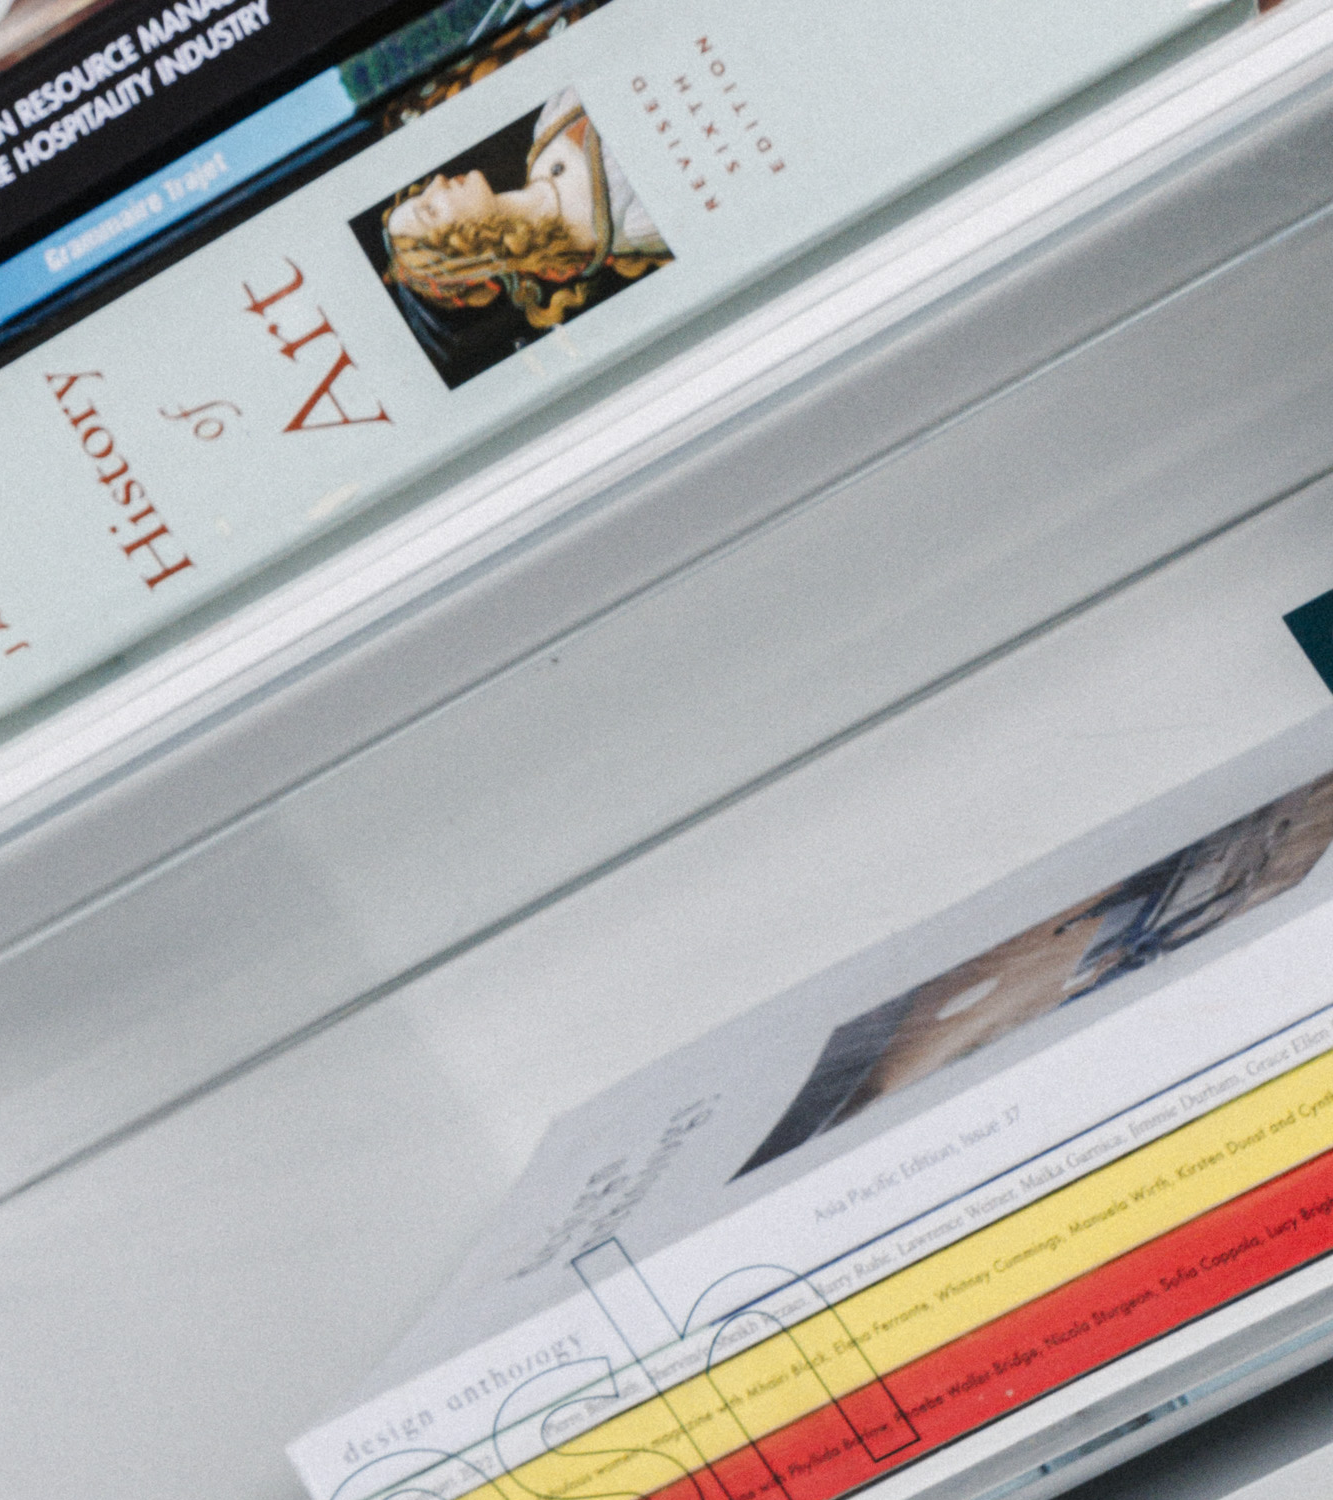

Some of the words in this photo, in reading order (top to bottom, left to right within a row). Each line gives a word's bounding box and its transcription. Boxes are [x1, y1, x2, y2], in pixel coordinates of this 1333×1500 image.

[13, 32, 141, 130] RESOURCE
[14, 66, 156, 175] HOSPITALITY
[632, 75, 720, 212] REVISED
[674, 74, 740, 174] SIXTH
[695, 34, 786, 175] EDITION
[43, 191, 164, 274] Grammaire
[161, 151, 229, 202] Trajet
[242, 256, 395, 435] Art
[45, 369, 196, 590] History
[158, 398, 244, 441] of
[814, 1201, 849, 1224] Asia
[846, 1170, 901, 1204] Pacific
[898, 1143, 963, 1181] Edition,
[958, 1119, 1002, 1145] Issue
[1003, 1104, 1020, 1126] 37
[895, 1212, 965, 1257] Lawrence
[1018, 1160, 1065, 1194] Maika
[1244, 1044, 1291, 1077] Grace
[1289, 1024, 1329, 1054] Ellen
[932, 1265, 992, 1306] Whitney
[990, 1226, 1067, 1276] Cummings,
[1065, 1194, 1128, 1236] Manuela
[1126, 1171, 1175, 1204] Wirth,
[1173, 1145, 1225, 1181] Kirsten
[1224, 1124, 1266, 1155] Dunst
[1265, 1109, 1296, 1134] and
[1041, 1315, 1090, 1350] Nicola
[1157, 1261, 1199, 1292] Sofia
[1196, 1228, 1264, 1275] Coppola,
[1262, 1211, 1300, 1242] Lucy
[342, 1411, 435, 1465] design
[445, 1333, 585, 1412] anthology
